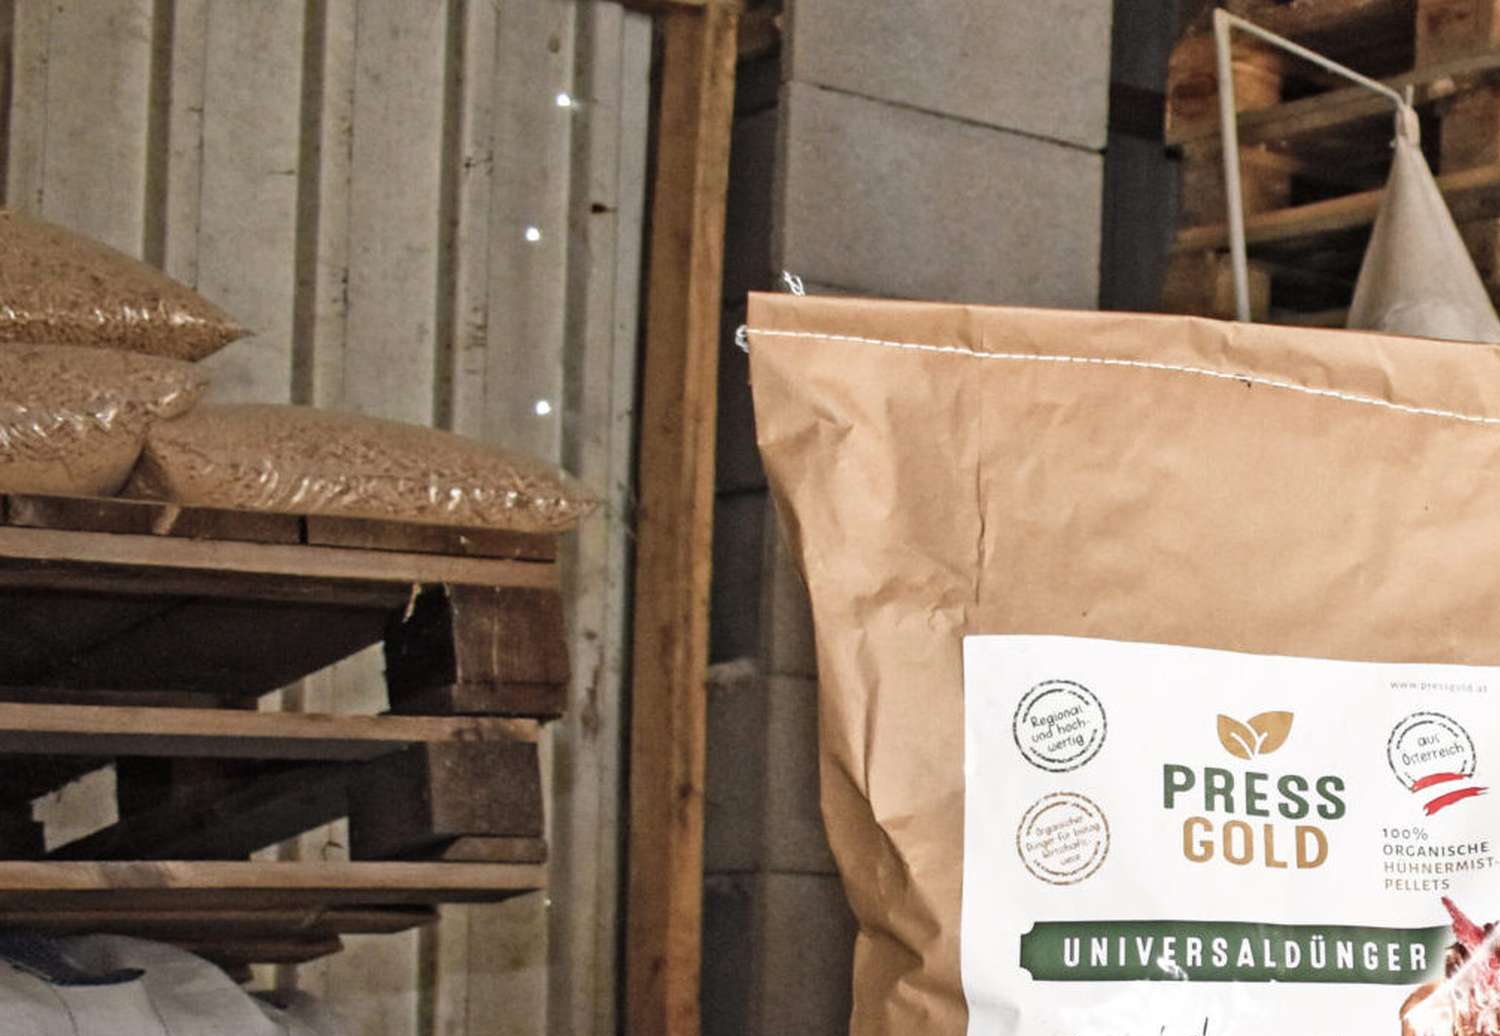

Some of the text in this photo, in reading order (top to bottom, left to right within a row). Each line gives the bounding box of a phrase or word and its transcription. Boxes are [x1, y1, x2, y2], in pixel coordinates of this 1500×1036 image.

[1030, 705, 1083, 728] Regional
[1032, 725, 1053, 743] und
[1417, 734, 1440, 747] aus
[1047, 735, 1084, 752] wertig
[1402, 742, 1464, 766] Österreich
[1163, 763, 1346, 820] PRESS
[1183, 816, 1329, 869] GOLD
[1382, 827, 1428, 840] 100%
[1383, 841, 1490, 857] ORGANISCHE
[1385, 878, 1450, 891] PELLETS
[1063, 935, 1427, 972] UNIVERSALDÜNGER
